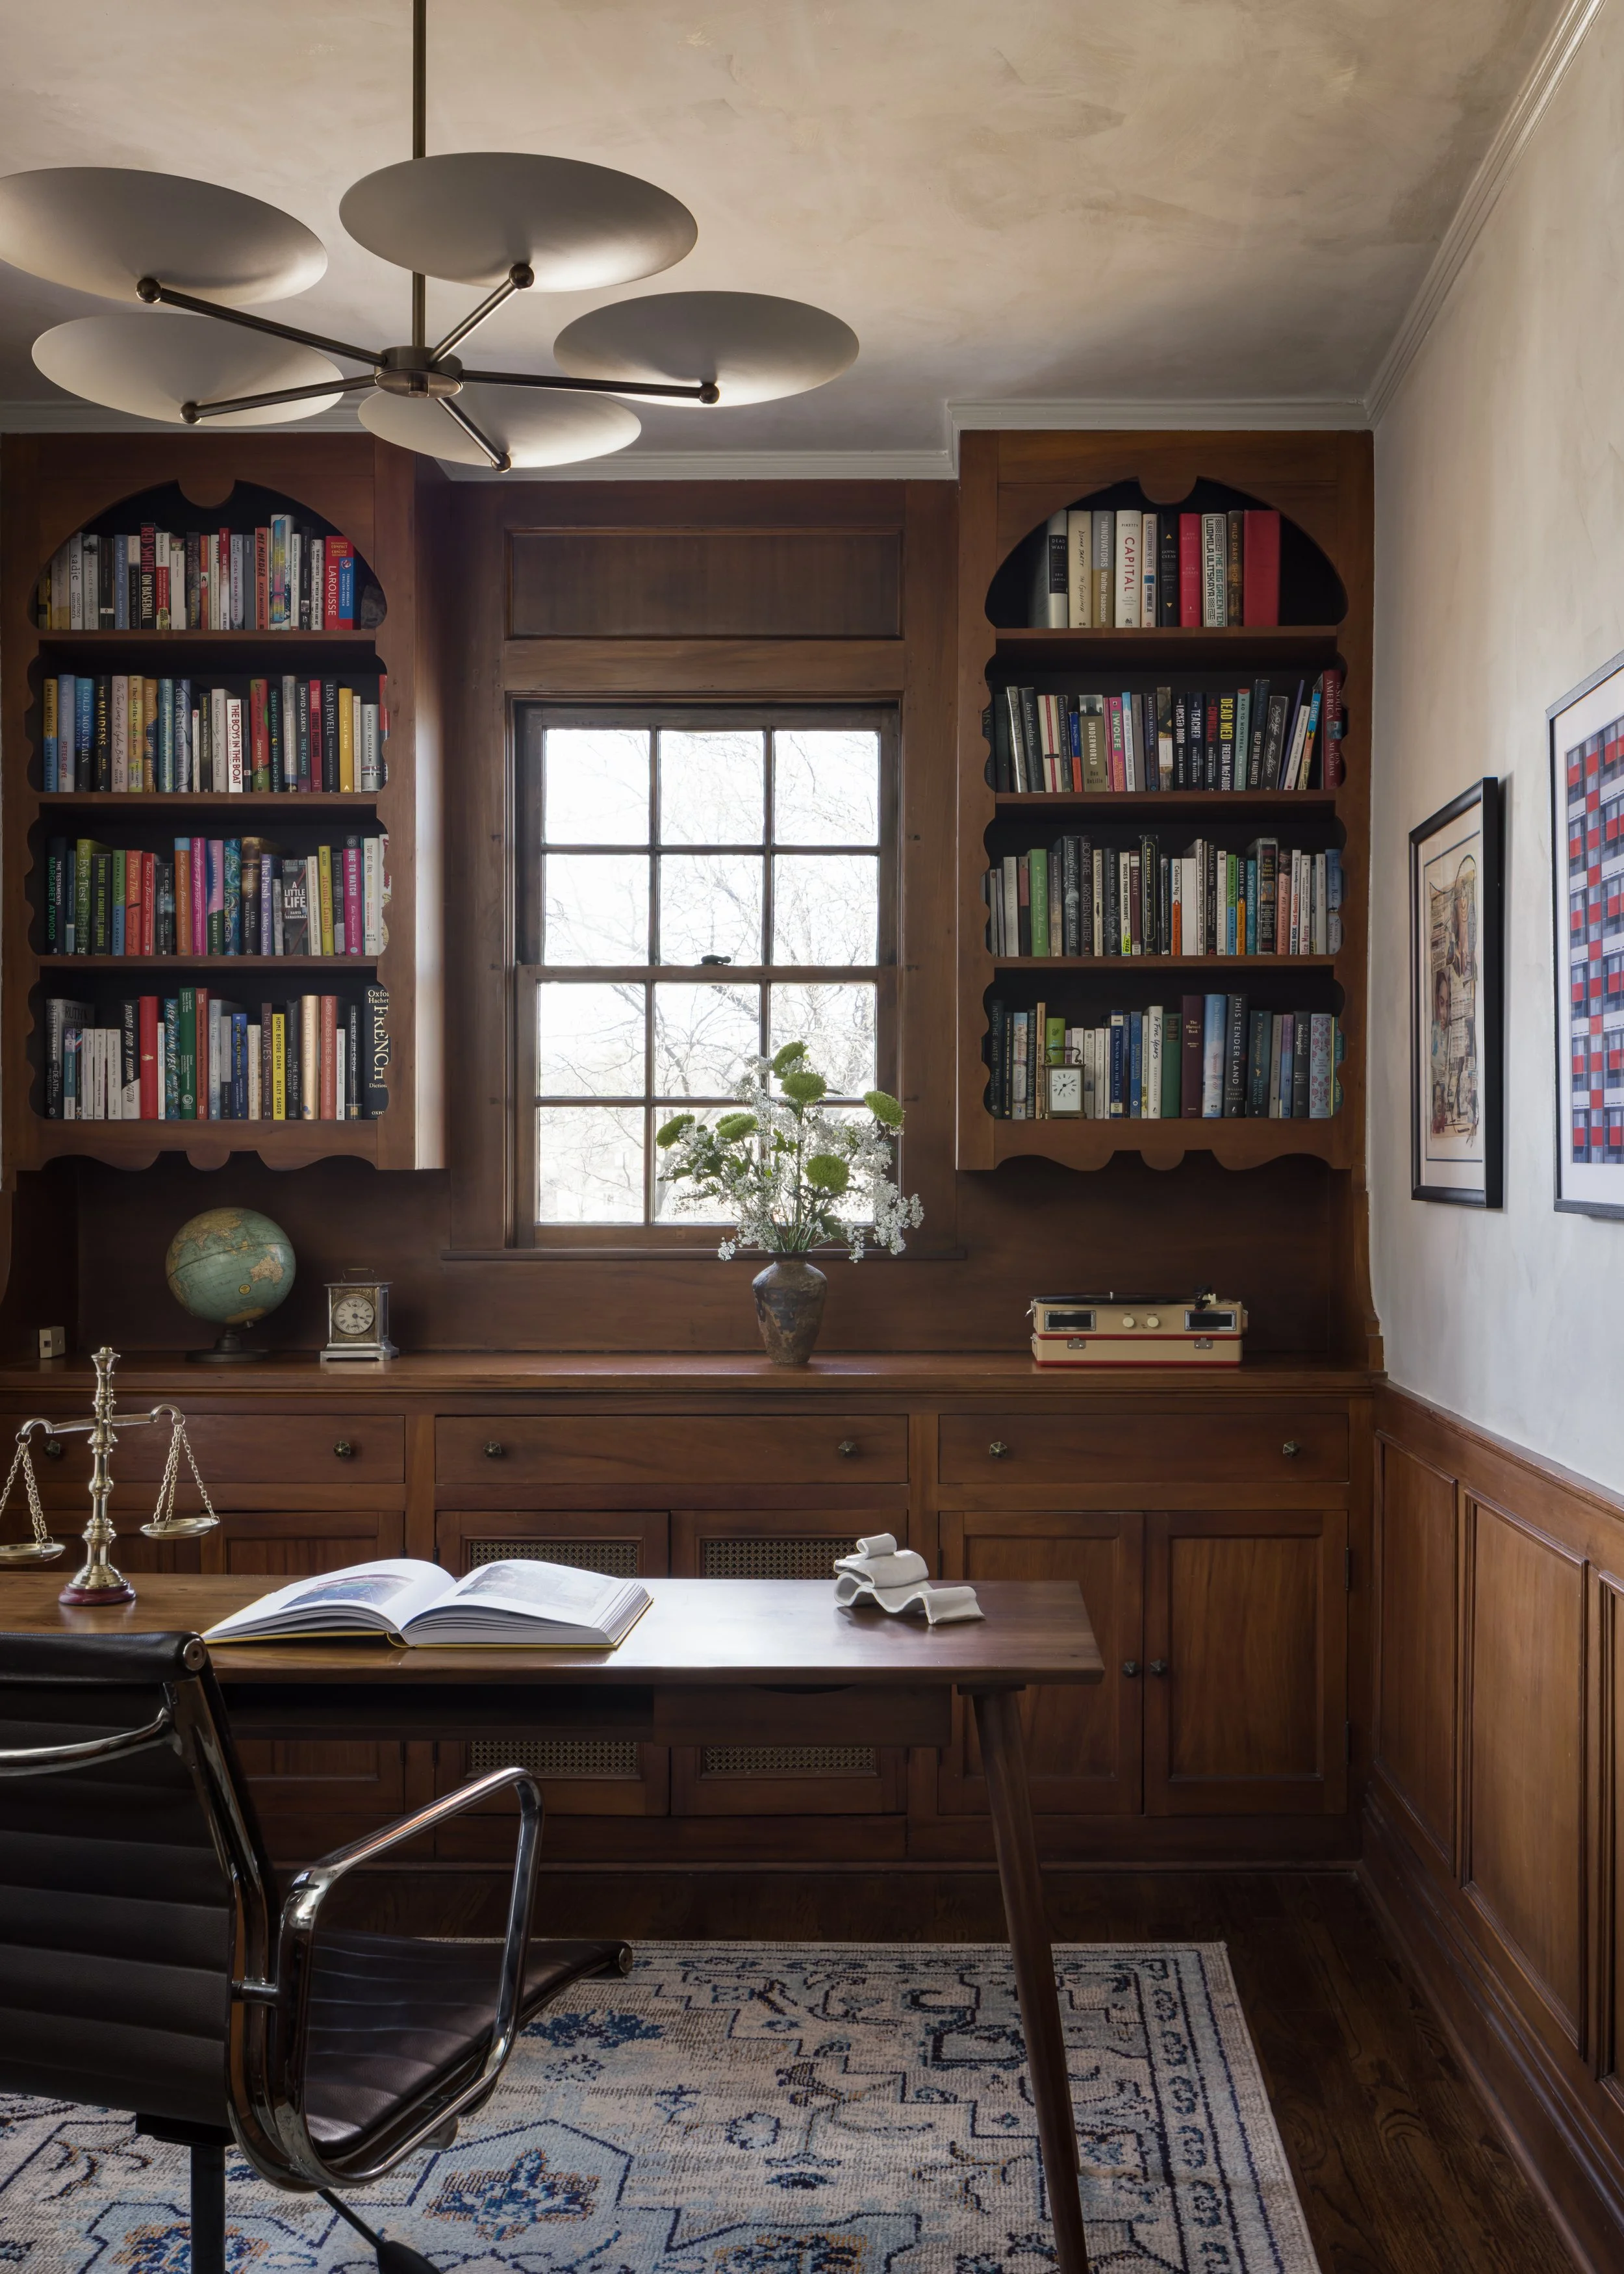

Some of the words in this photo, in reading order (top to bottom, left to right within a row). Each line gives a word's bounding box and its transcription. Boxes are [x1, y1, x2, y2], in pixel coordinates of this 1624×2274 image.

[141, 527, 155, 543] RED
[258, 533, 265, 544] MY
[71, 554, 81, 580] sadie
[141, 546, 154, 572] SMITH
[1124, 537, 1135, 591] CAPITAL
[142, 574, 152, 585] ON
[328, 566, 336, 615] LAROUSSE
[142, 587, 152, 619] BASEBALL
[1176, 706, 1184, 726] LOCKED
[1221, 698, 1233, 719] DEAD
[325, 705, 334, 735] JEWELL
[1191, 709, 1200, 738] TEACHER
[1221, 722, 1232, 739] MED
[1088, 722, 1097, 765] UNDERWORLD
[1222, 744, 1230, 763] FREIDA
[1221, 765, 1230, 791] McFADDE
[1250, 761, 1260, 784] HAUNTED
[78, 860, 88, 877] Eye
[79, 880, 88, 902] Test
[1173, 887, 1179, 895] Ng
[285, 897, 306, 908] LIFE
[166, 1003, 175, 1021] ASK
[166, 1023, 176, 1049] AGAIN,
[374, 1005, 388, 1080] FRENCH
[1150, 1040, 1160, 1059] Years
[167, 1053, 176, 1070] YES
